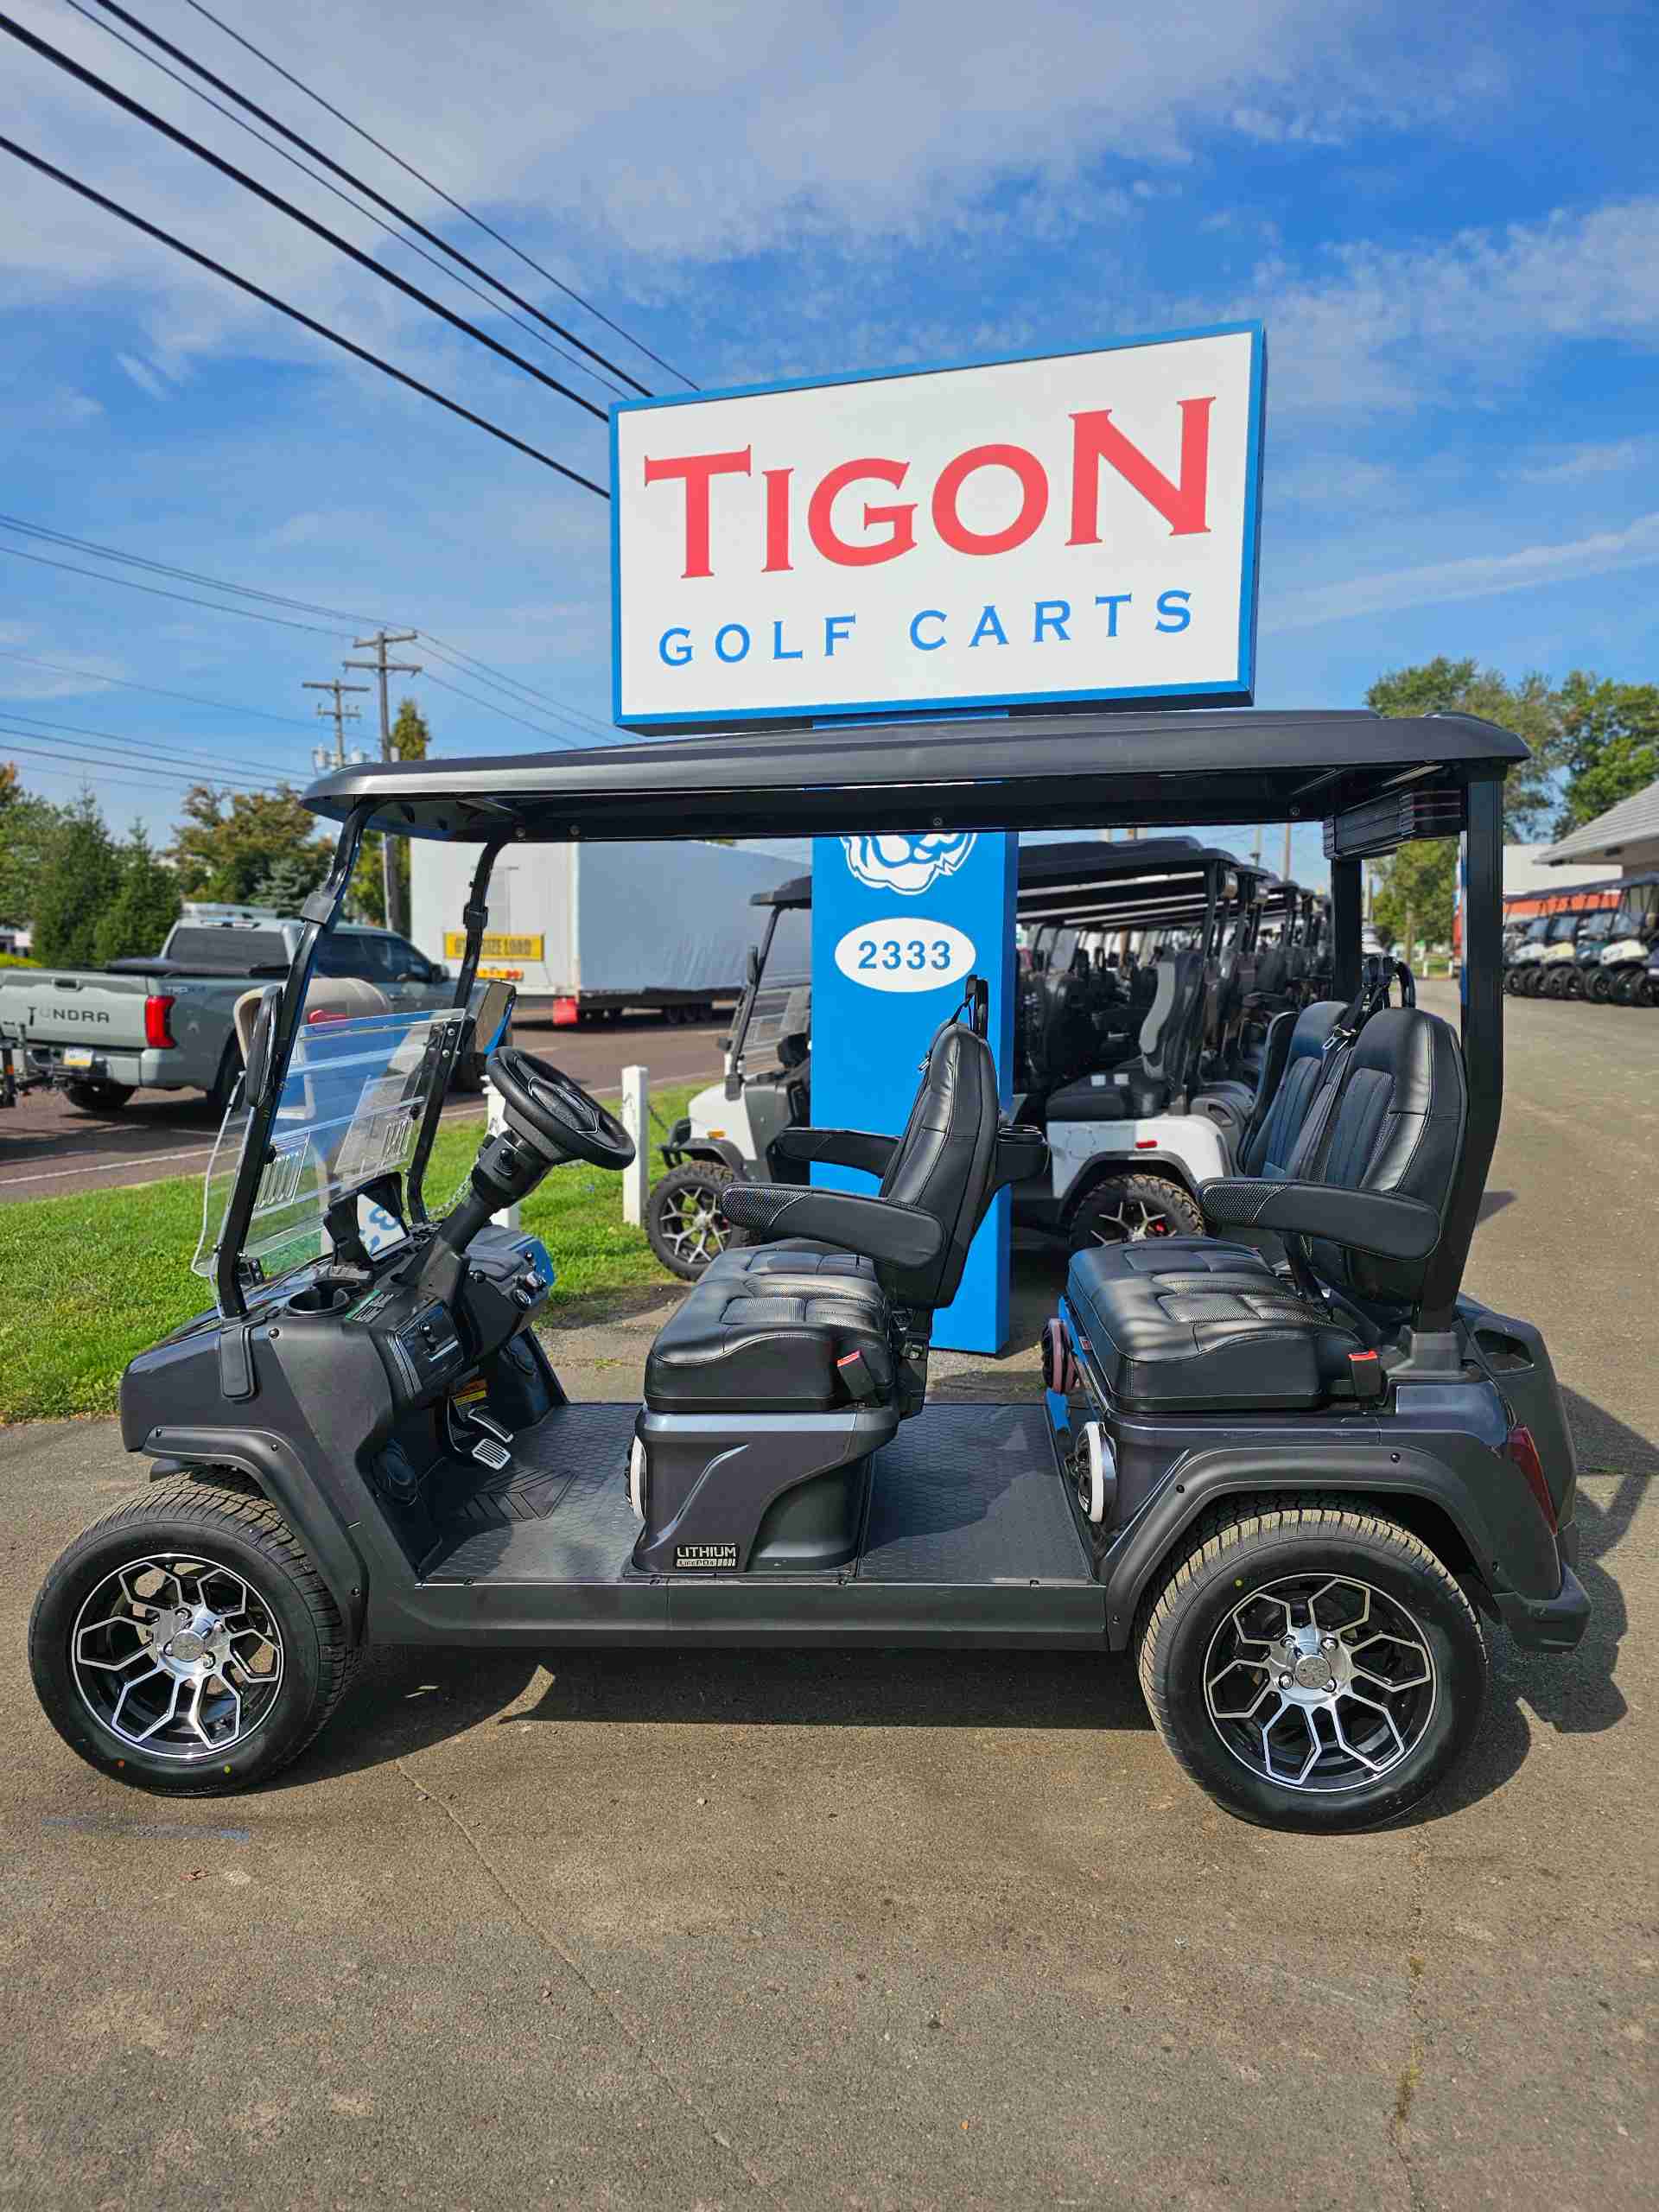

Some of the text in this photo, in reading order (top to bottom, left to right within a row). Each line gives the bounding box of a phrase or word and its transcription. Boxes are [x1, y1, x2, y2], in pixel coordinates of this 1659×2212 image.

[644, 396, 1217, 579] TIGON
[658, 589, 1192, 667] GOLF CARTS
[858, 939, 951, 970] 2333
[28, 1005, 111, 1027] TUNDRA
[677, 1545, 736, 1558] LITHIUM
